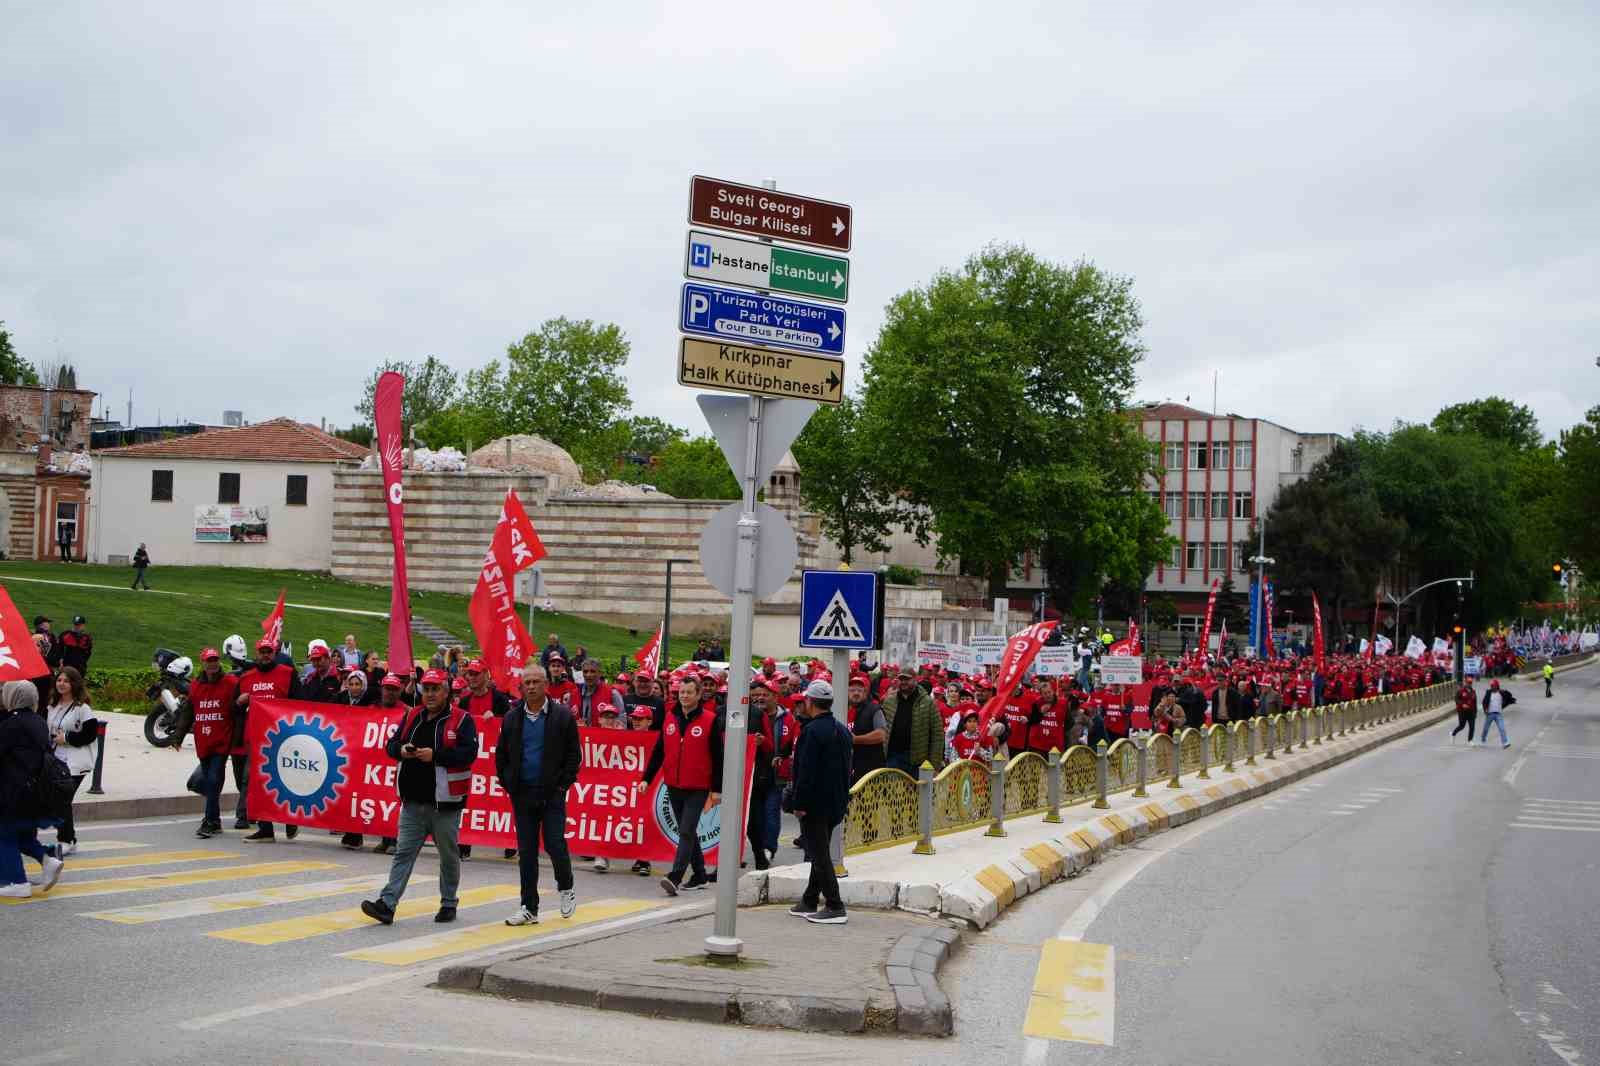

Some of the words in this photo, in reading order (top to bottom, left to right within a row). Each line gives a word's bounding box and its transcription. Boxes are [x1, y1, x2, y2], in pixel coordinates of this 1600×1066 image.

[717, 189, 754, 208] Sveti
[759, 197, 805, 218] Georgi
[710, 206, 757, 226] Bulgar
[762, 216, 812, 236] Kilisesi
[711, 252, 769, 272] Hastane
[771, 258, 829, 283] İstanbul
[713, 292, 758, 309] Turizm
[762, 300, 827, 320] Otobüsleri
[719, 319, 746, 332] Tour
[749, 326, 772, 337] Bus
[776, 330, 819, 345] Parking
[740, 310, 769, 324] Park
[774, 315, 800, 329] Yeri
[719, 346, 792, 369] Kırkpınar
[683, 362, 719, 382] Halk
[724, 368, 824, 396] Kütüphanesi
[282, 751, 319, 772] DİSK
